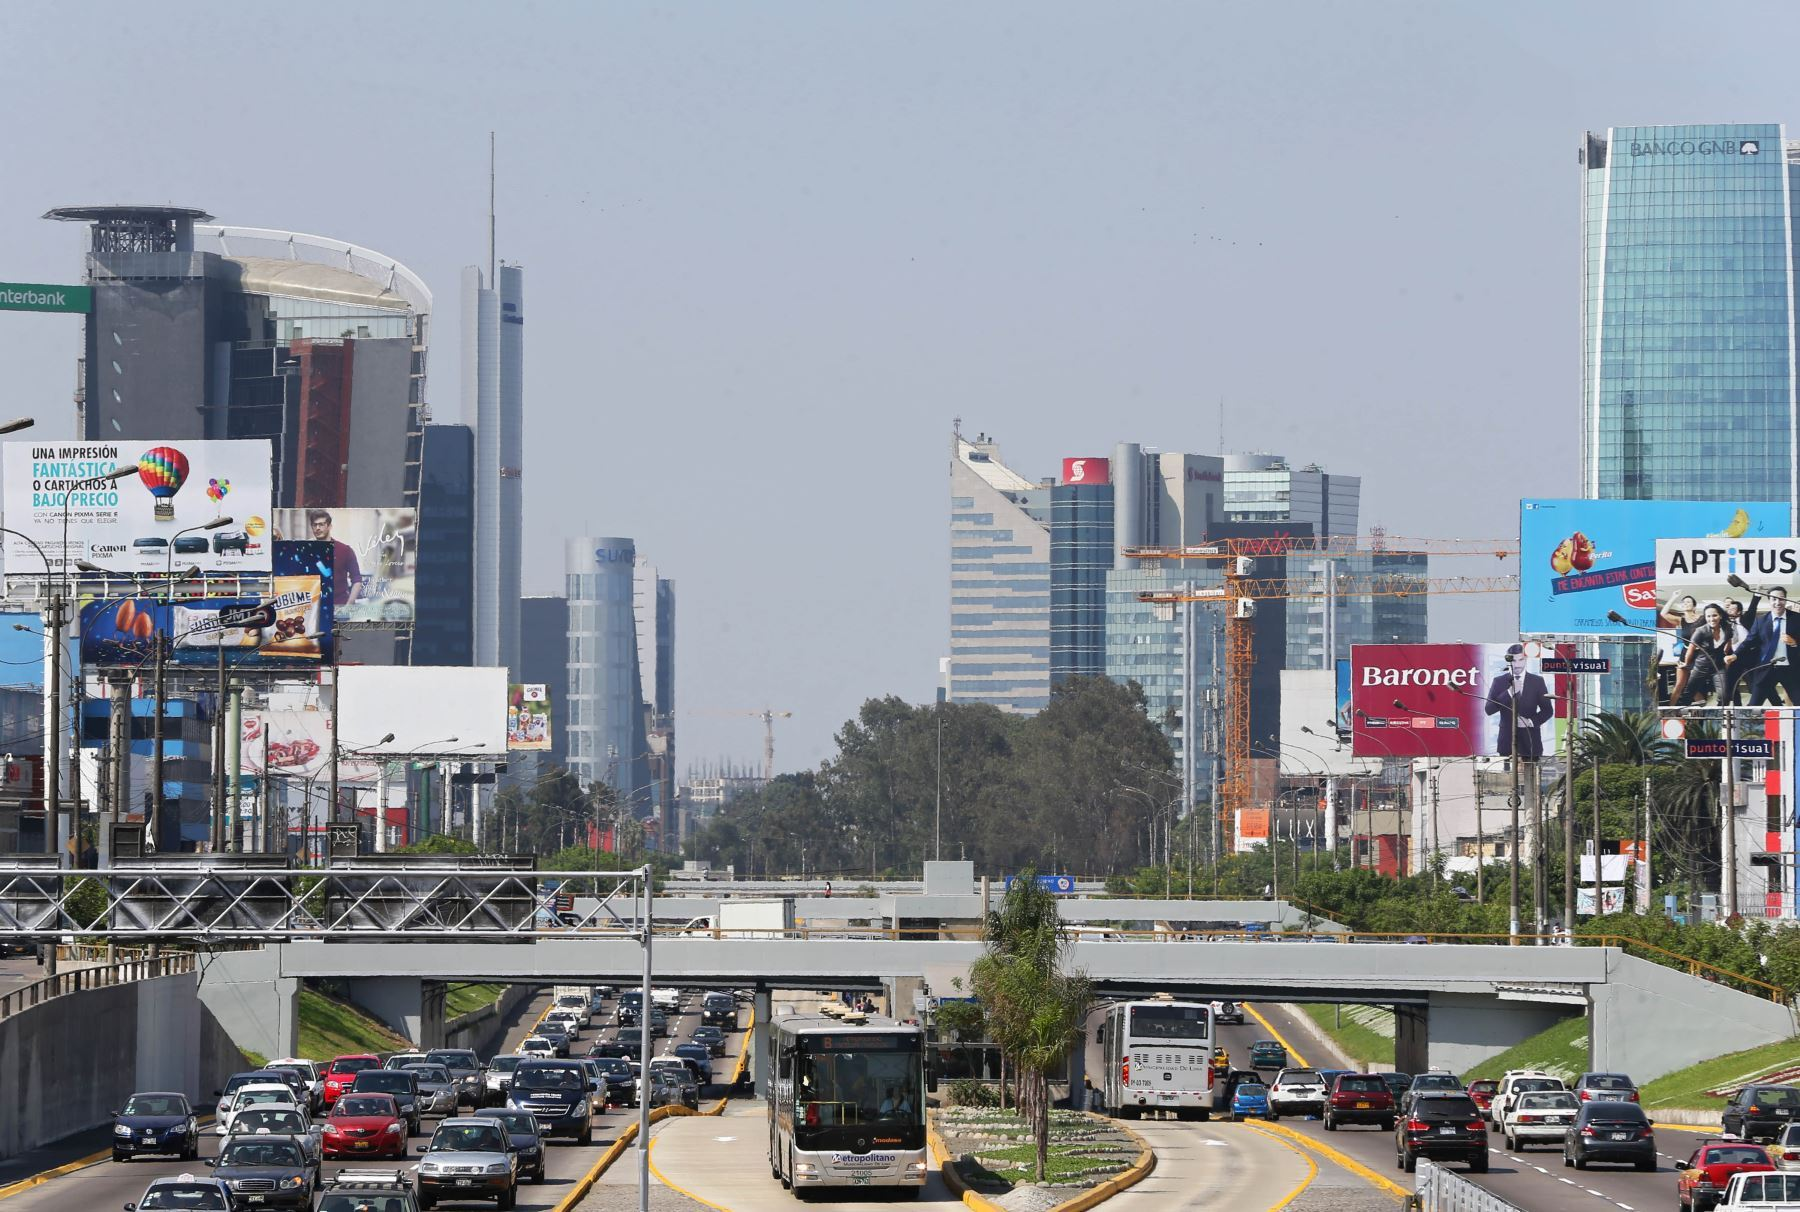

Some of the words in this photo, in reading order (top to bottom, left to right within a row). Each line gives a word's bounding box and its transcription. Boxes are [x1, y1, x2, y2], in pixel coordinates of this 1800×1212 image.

[1630, 141, 1695, 157] BANCO
[1699, 140, 1736, 156] GNB
[0, 288, 66, 306] nterbank
[32, 447, 55, 459] UNA
[59, 444, 118, 459] IMPRESIÓN
[33, 459, 116, 478] FANTÁSTICA
[33, 479, 41, 491] O
[44, 479, 107, 491] CARTUCHOS
[110, 478, 118, 490] A
[33, 492, 67, 507] BAJO
[71, 491, 119, 507] PRECIO
[90, 543, 128, 553] Canon
[273, 591, 312, 609] UBLIME
[1361, 666, 1480, 686] Baronet
[831, 1153, 896, 1165] Metropolitano
